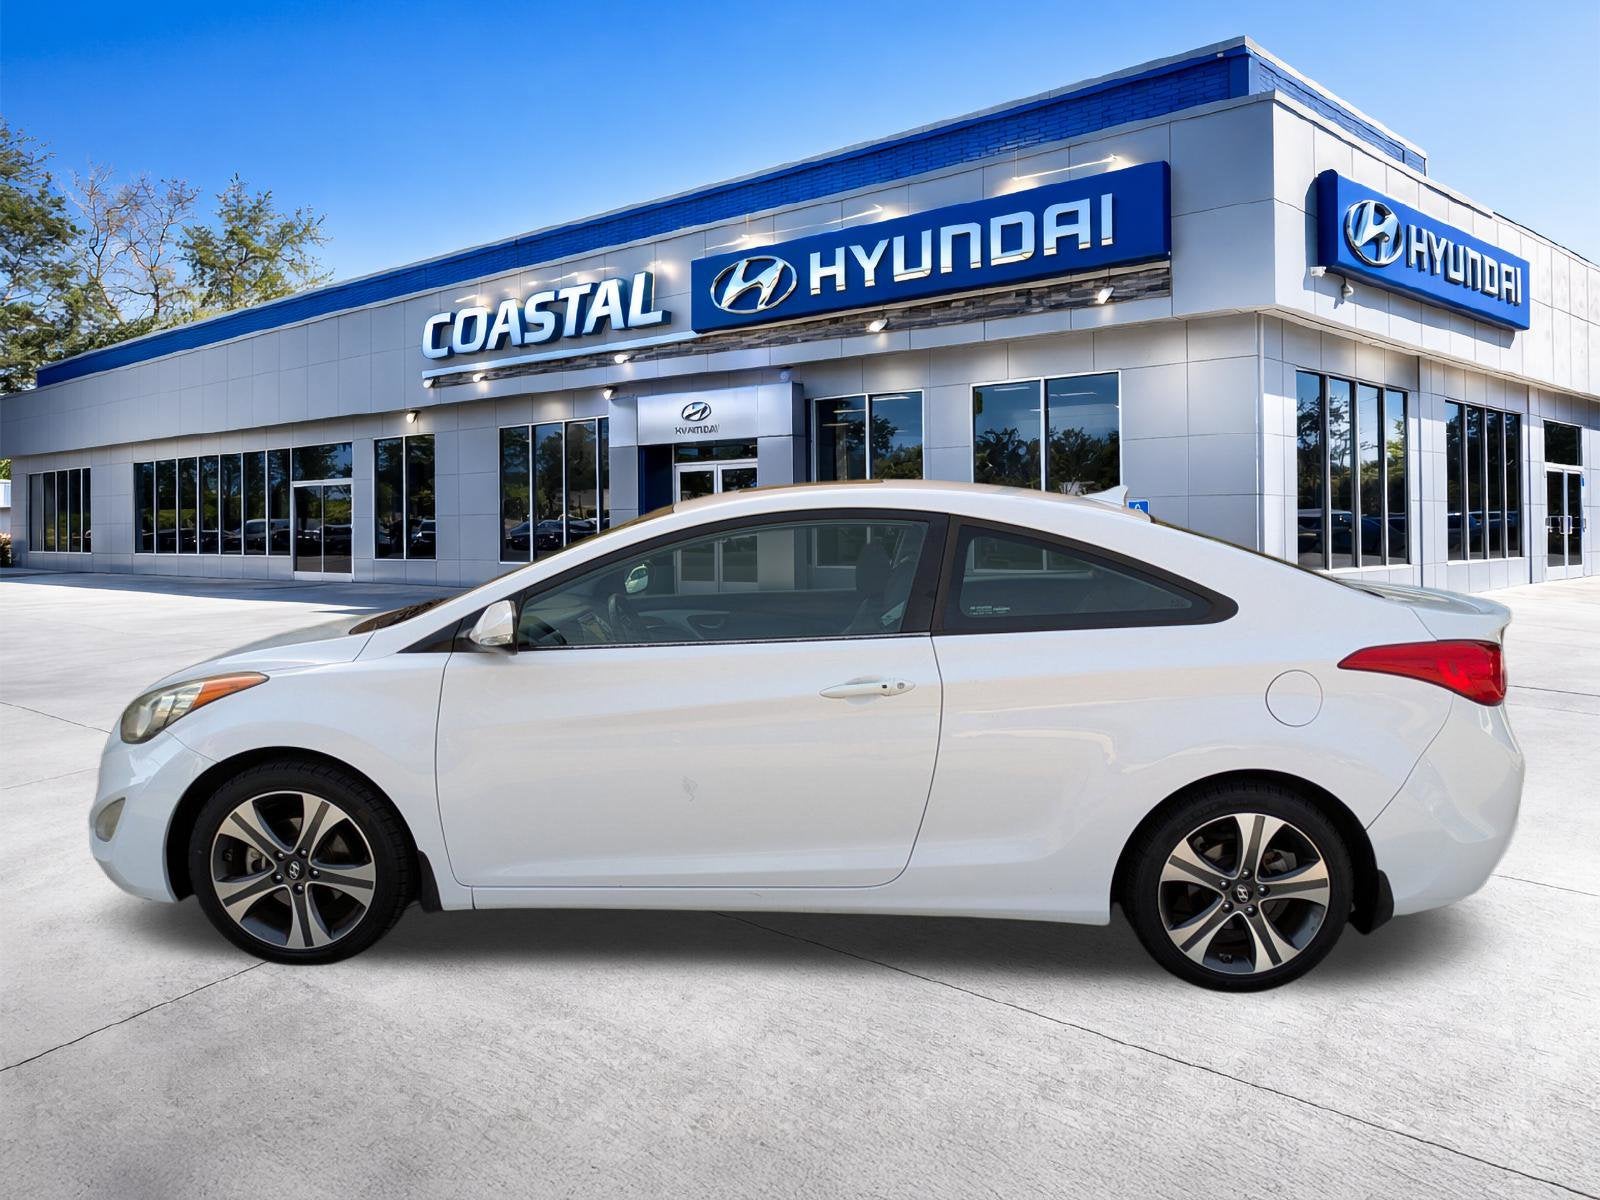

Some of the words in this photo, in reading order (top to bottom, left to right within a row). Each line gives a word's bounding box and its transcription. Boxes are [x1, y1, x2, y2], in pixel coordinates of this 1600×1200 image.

[809, 192, 1114, 296] HYUNDAI
[1406, 223, 1523, 306] HYUNDAI
[422, 271, 671, 360] COASTAL
